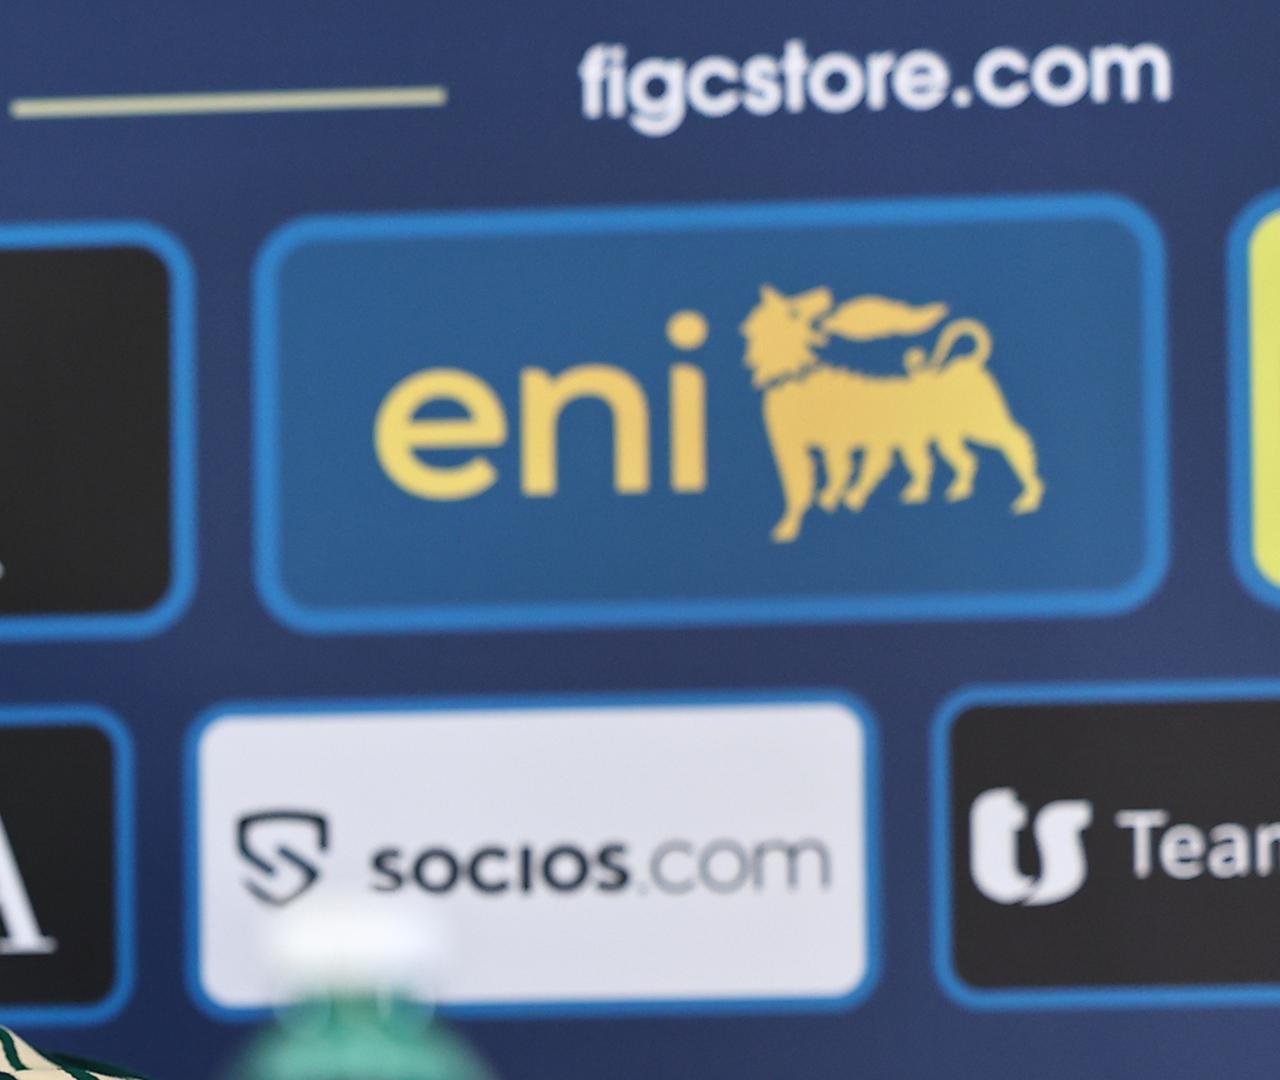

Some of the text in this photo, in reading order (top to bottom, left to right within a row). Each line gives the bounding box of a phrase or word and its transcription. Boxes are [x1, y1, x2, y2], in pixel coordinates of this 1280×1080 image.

[578, 38, 1173, 137] figcstore.com
[373, 310, 709, 500] eni
[369, 838, 833, 896] socios.com
